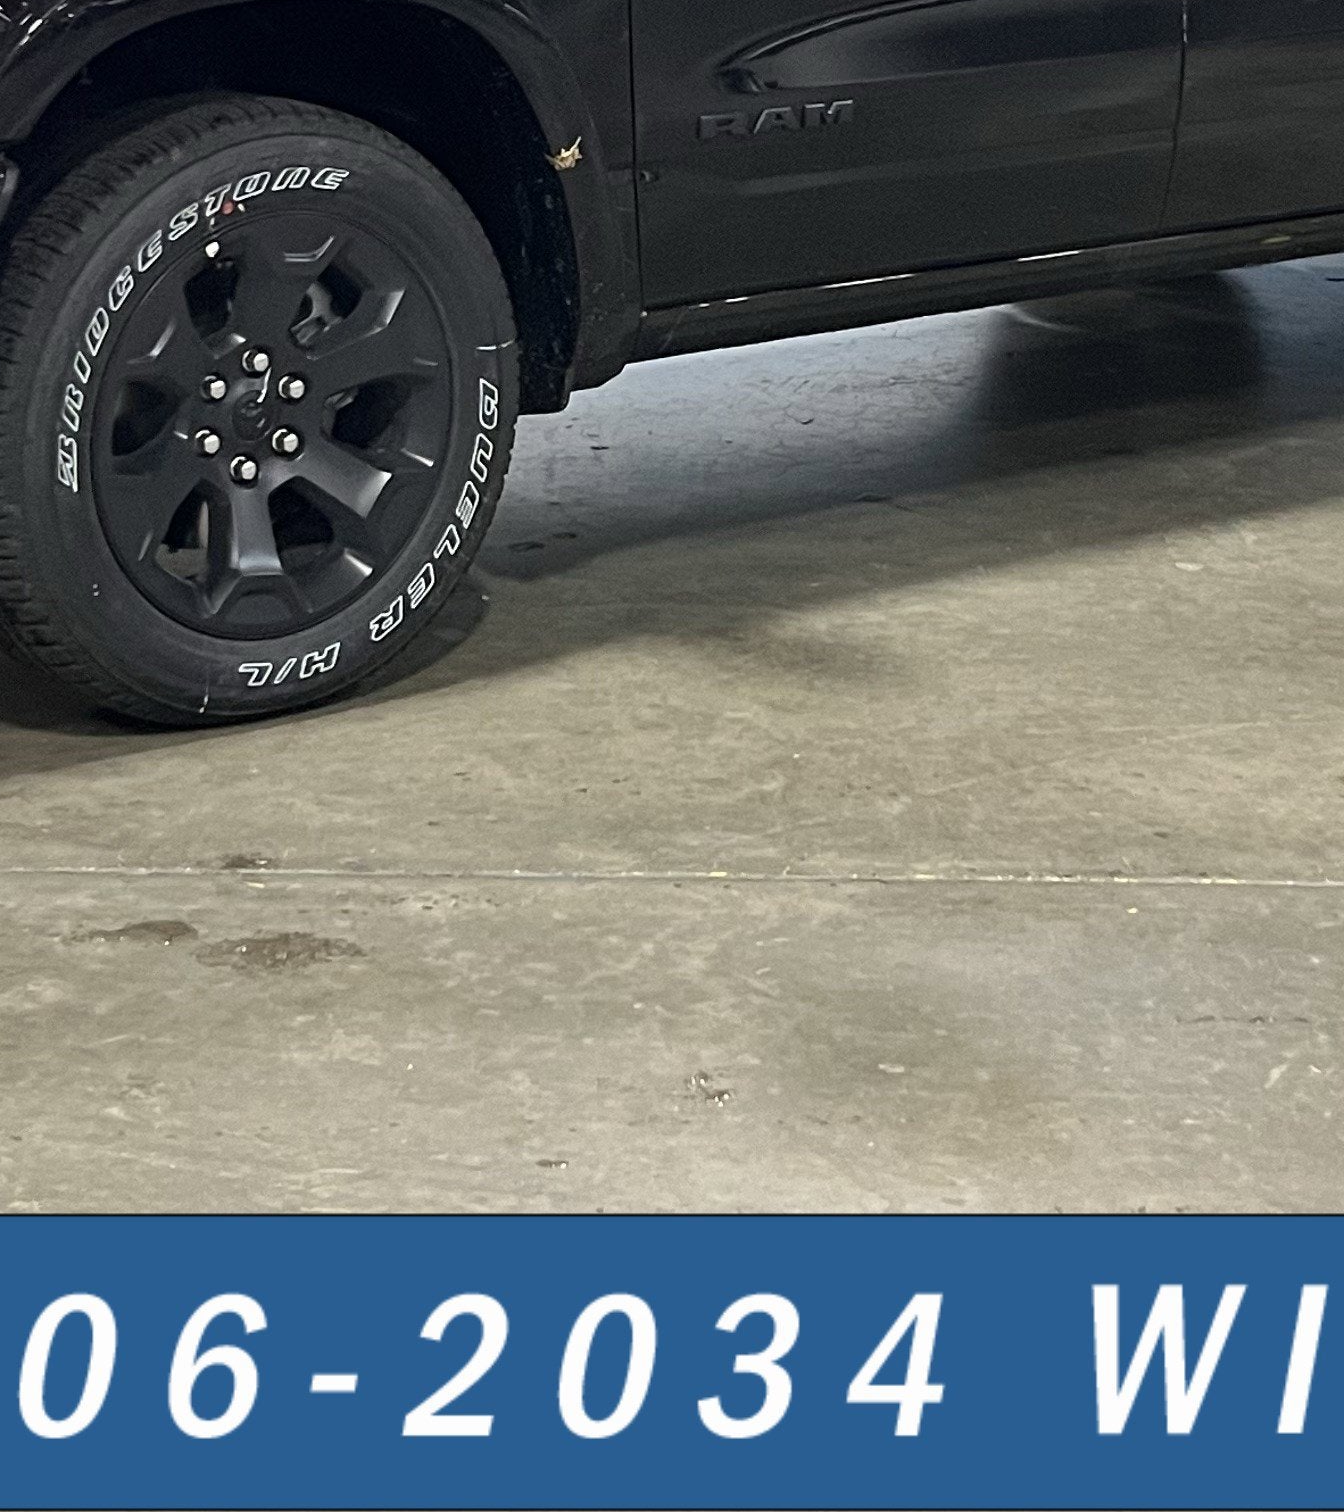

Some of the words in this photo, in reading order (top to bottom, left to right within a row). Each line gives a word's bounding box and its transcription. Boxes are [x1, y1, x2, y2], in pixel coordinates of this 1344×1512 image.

[697, 99, 854, 142] RAM
[58, 167, 351, 493] BRIDGESTONE
[368, 378, 500, 643] DUELER
[238, 642, 342, 687] H/L
